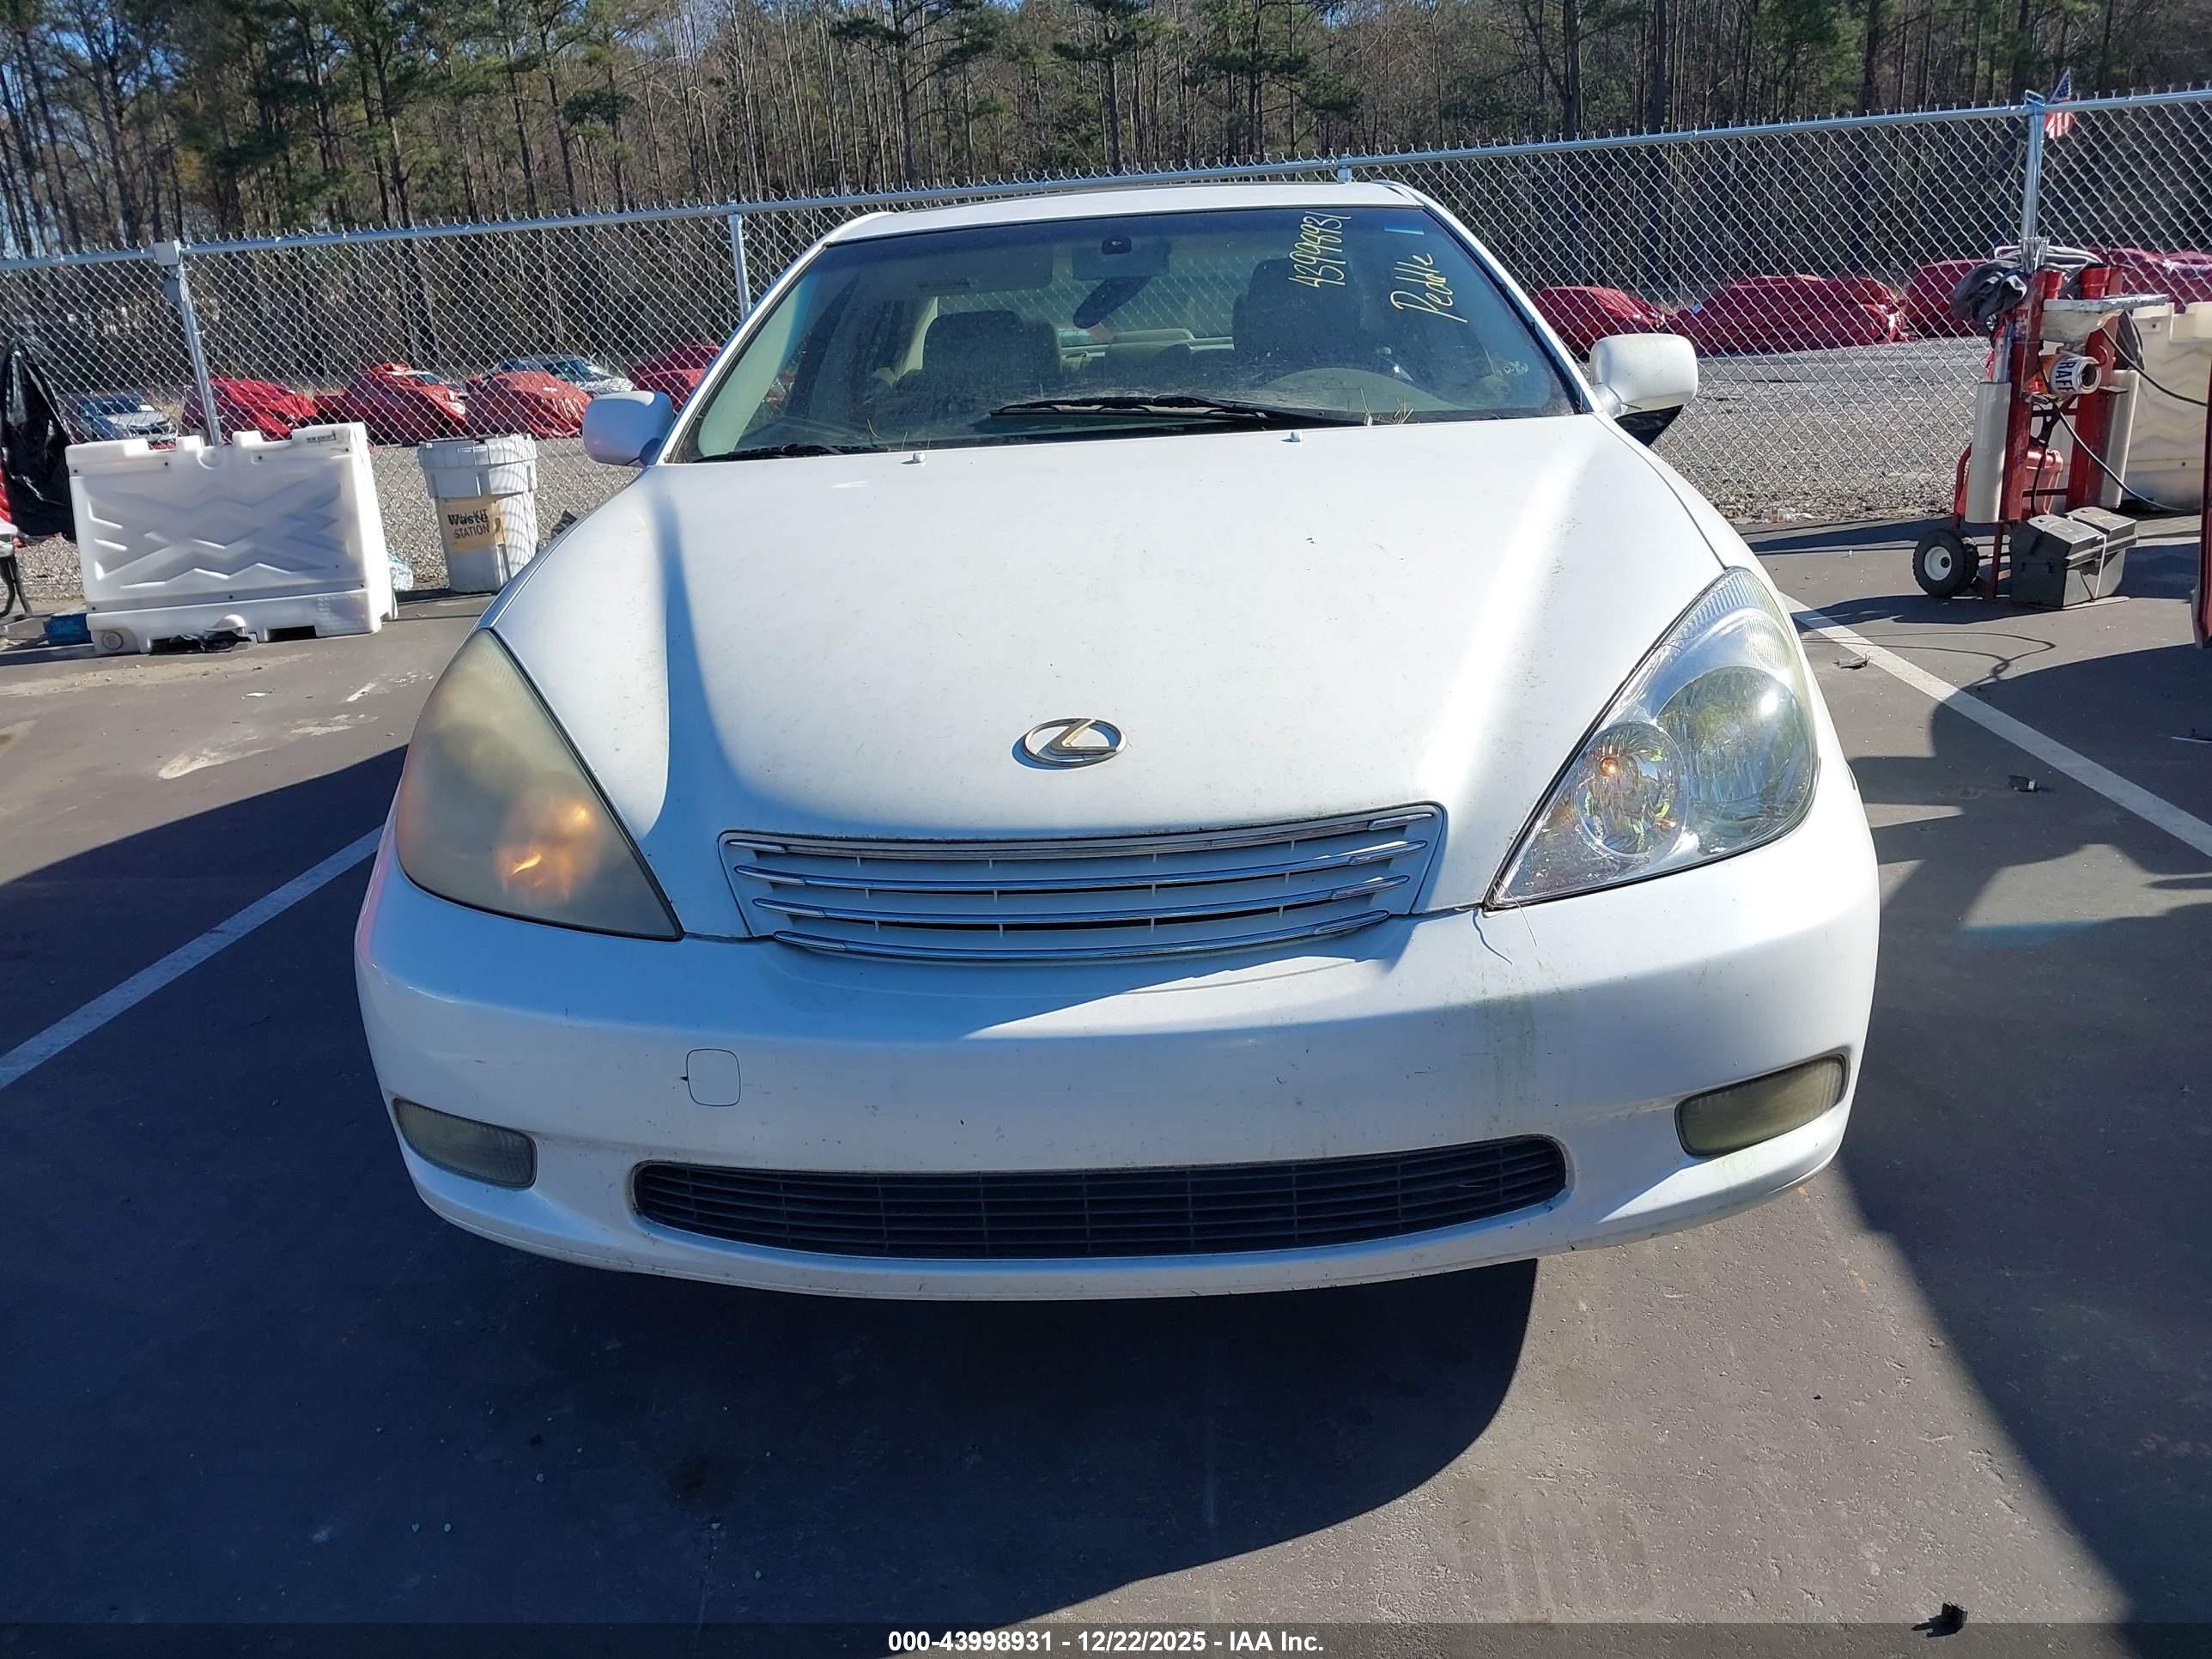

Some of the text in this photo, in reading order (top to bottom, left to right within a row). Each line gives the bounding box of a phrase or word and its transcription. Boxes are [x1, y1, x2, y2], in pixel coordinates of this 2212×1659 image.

[1287, 210, 1352, 289] 43998931
[1390, 252, 1468, 322] Peddle
[2055, 361, 2078, 392] RAFF
[453, 523, 490, 538] STATION
